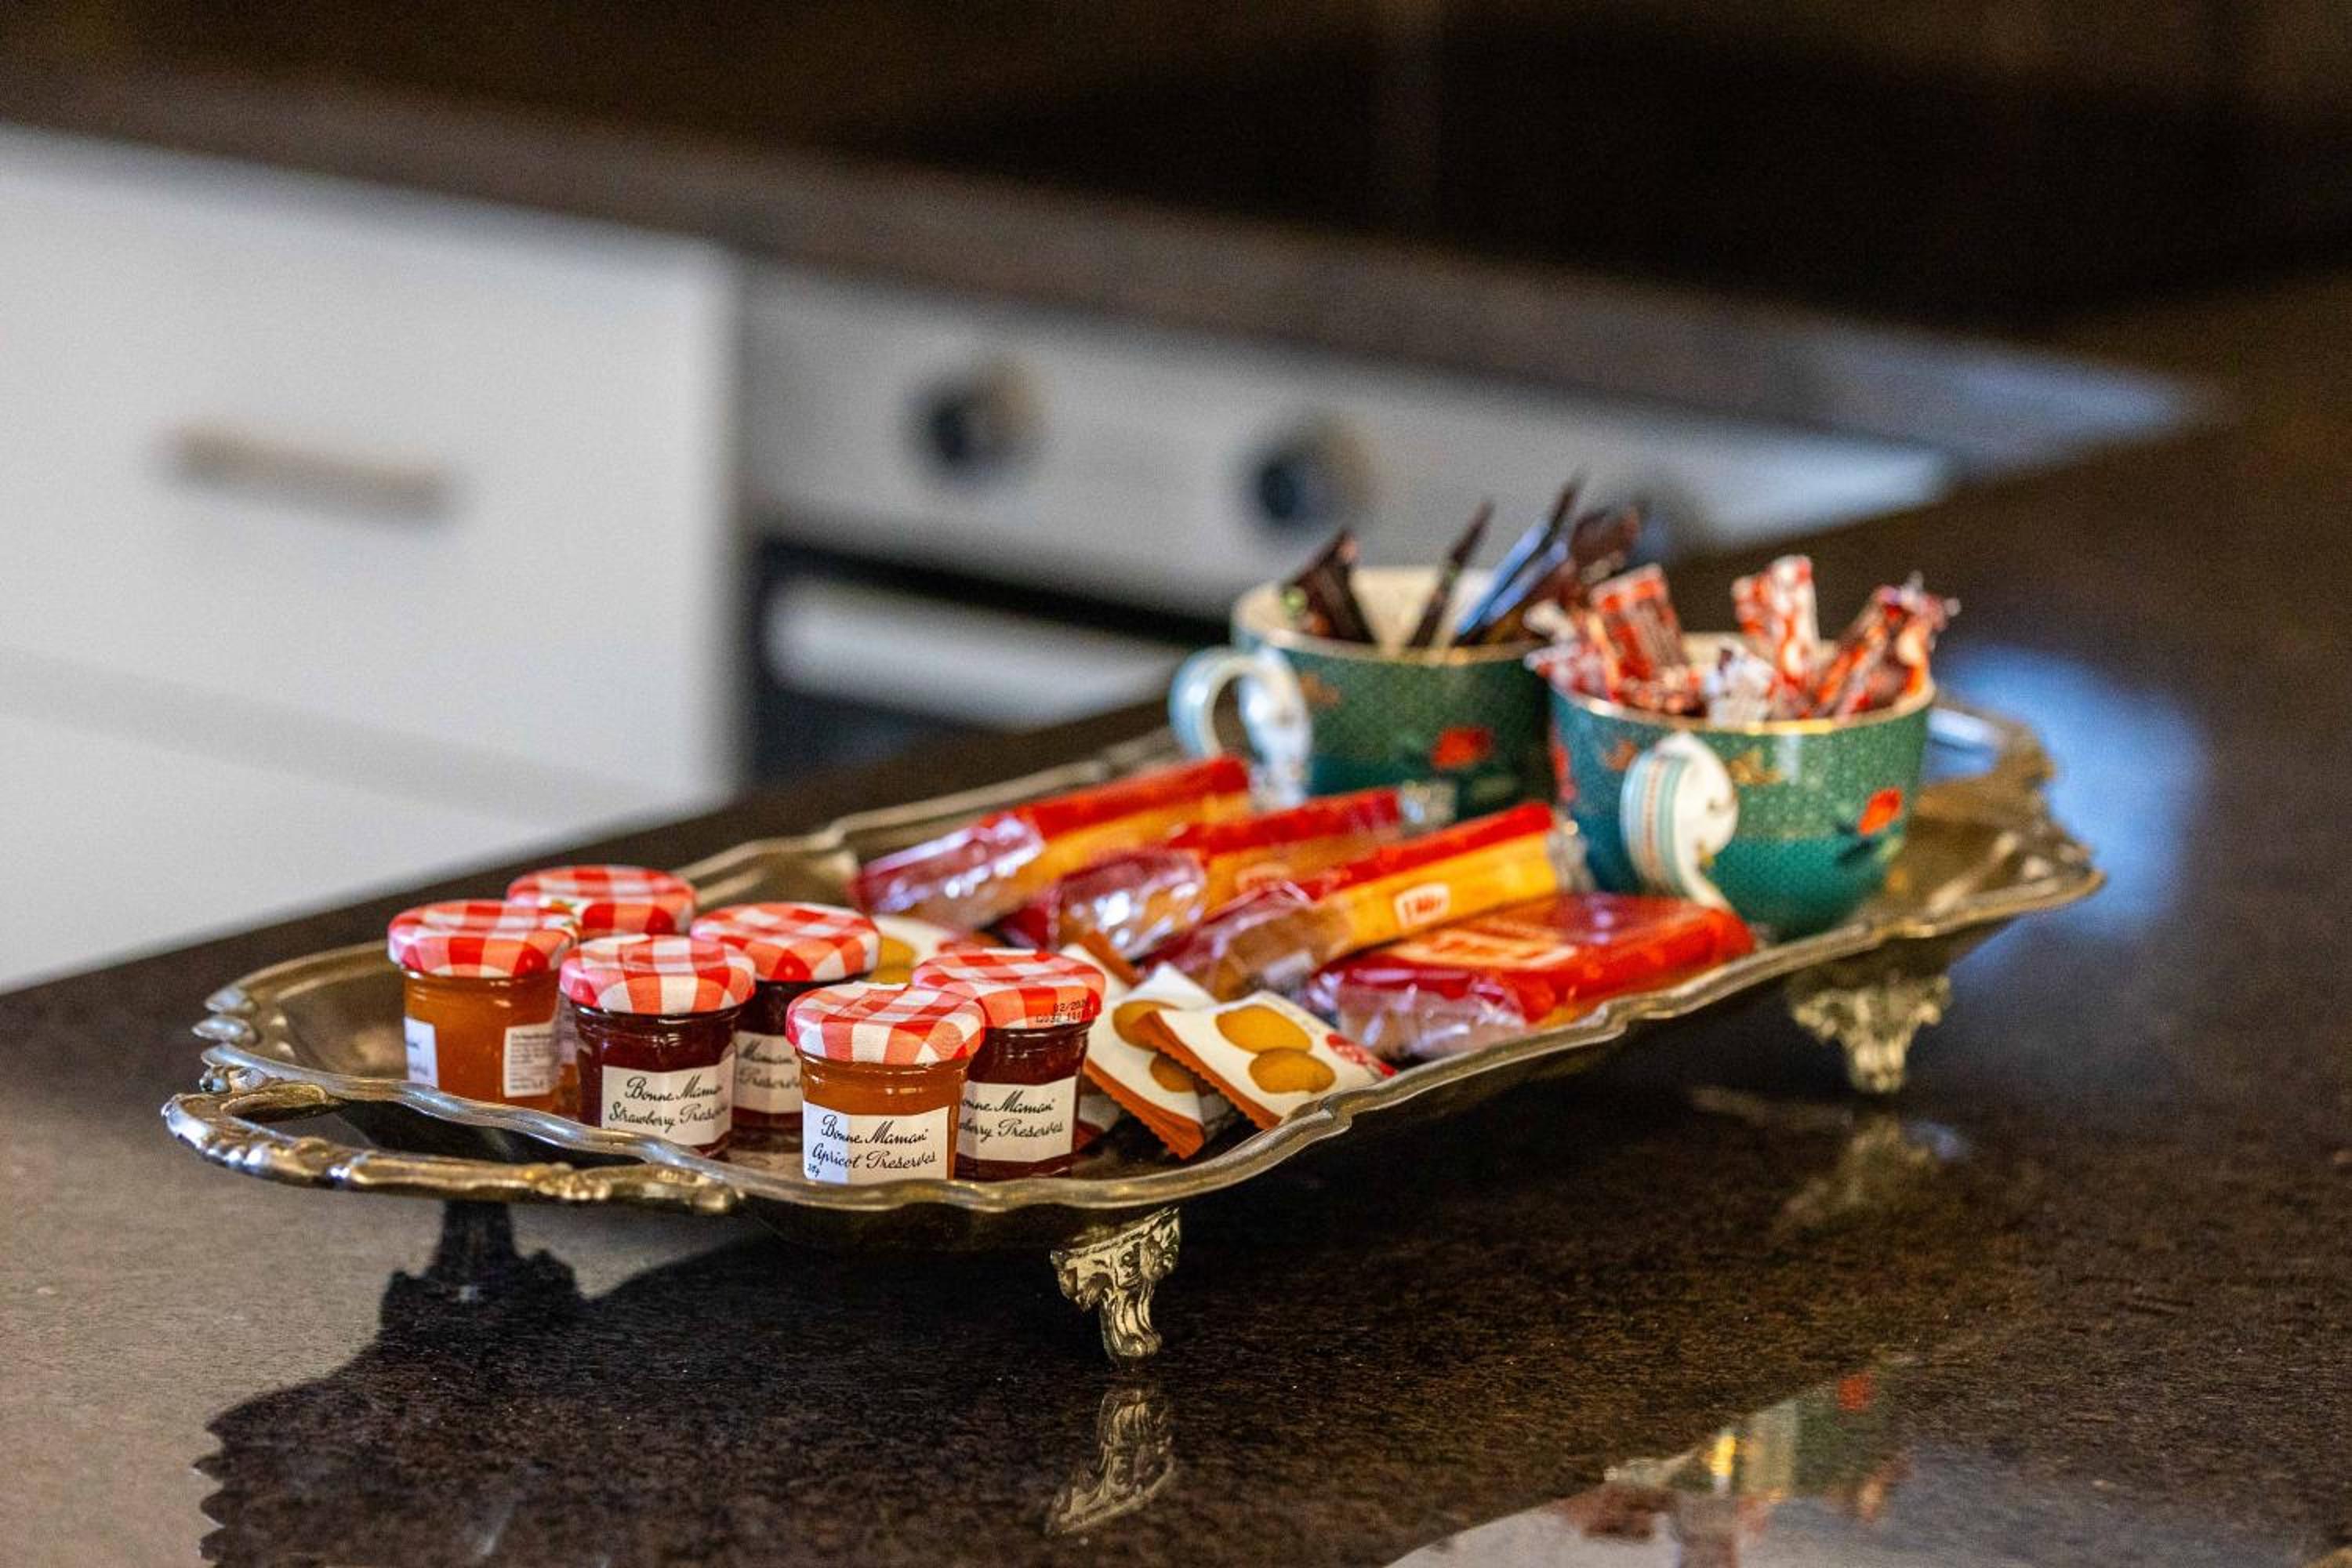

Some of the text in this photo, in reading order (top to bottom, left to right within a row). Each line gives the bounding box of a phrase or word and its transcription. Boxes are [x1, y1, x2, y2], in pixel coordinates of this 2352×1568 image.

[625, 1076, 676, 1102] Bonne
[962, 1090, 1056, 1114] onne Maman
[609, 1101, 676, 1134] Strawberry
[821, 1114, 929, 1145] Bonne Maman
[997, 1118, 1063, 1138] Preserves
[812, 1142, 938, 1170] Apricot Preserves
